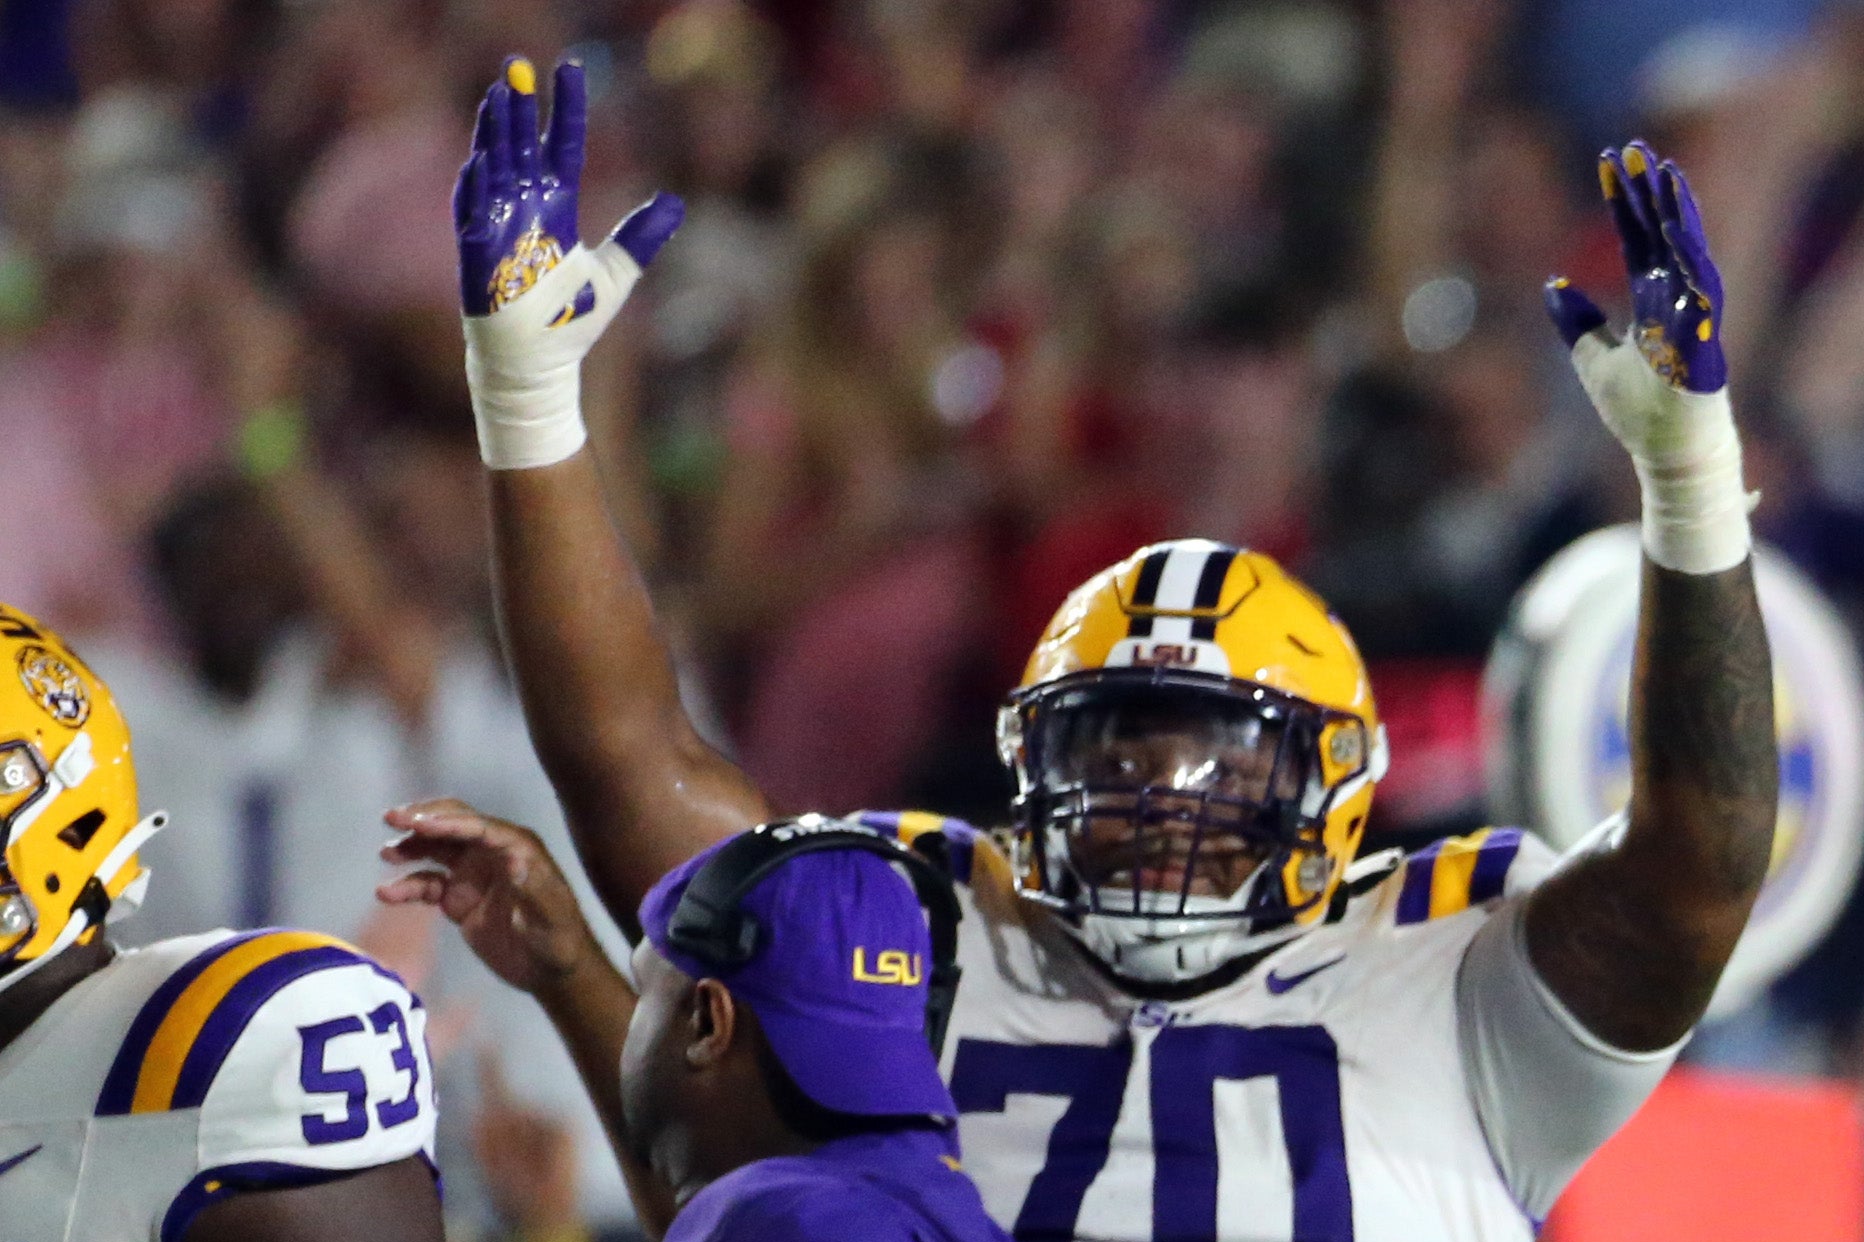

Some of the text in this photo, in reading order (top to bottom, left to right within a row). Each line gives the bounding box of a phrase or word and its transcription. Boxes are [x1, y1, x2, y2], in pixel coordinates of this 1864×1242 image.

[1131, 643, 1198, 667] LSU
[852, 945, 922, 986] LSU
[296, 1001, 420, 1145] 53
